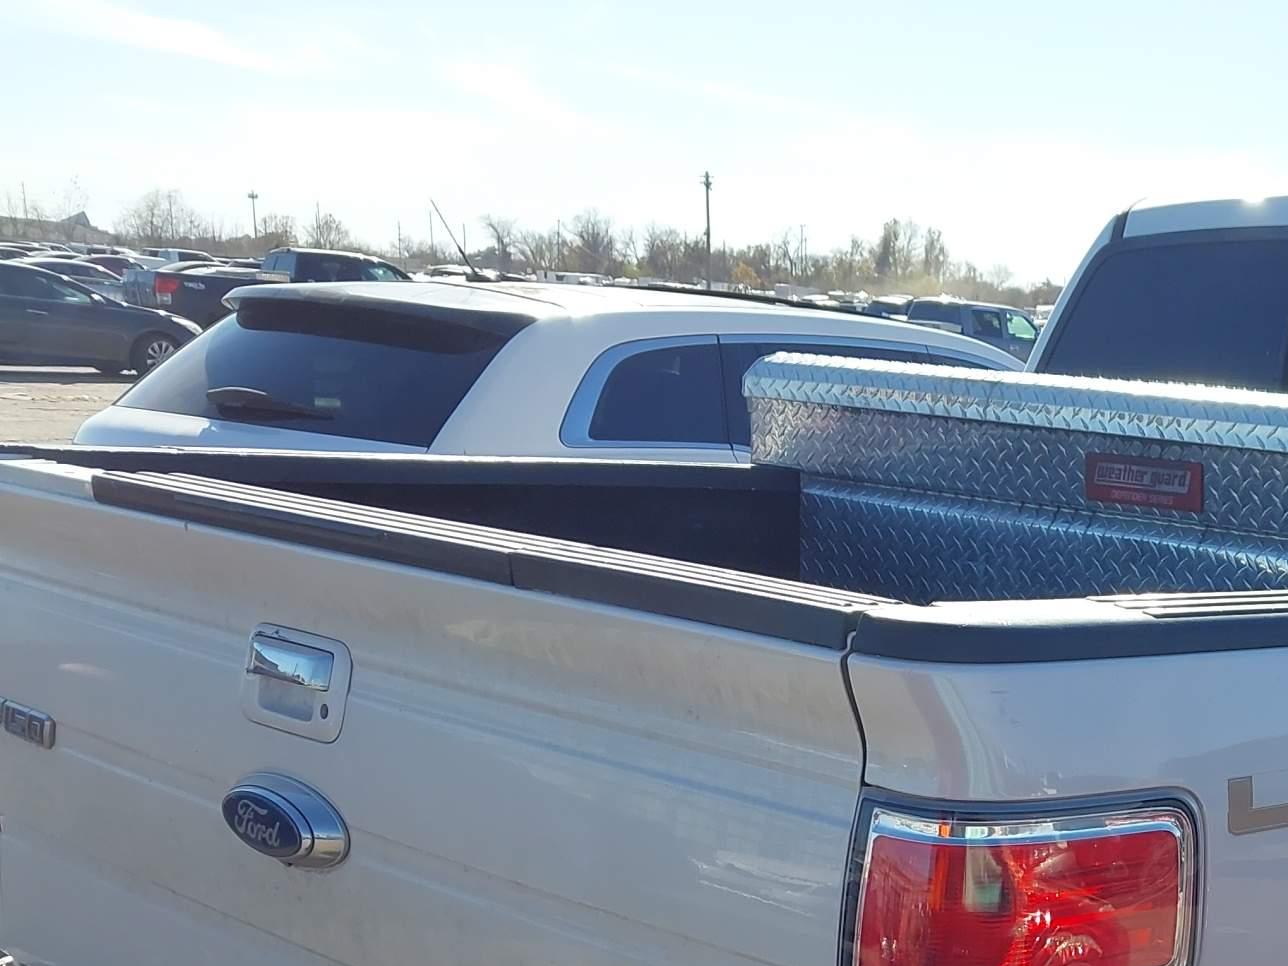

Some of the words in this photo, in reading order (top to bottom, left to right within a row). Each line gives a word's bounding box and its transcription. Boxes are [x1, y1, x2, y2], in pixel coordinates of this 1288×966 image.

[1095, 463, 1149, 484] weather
[1150, 471, 1187, 488] guard
[233, 799, 281, 848] Ford
